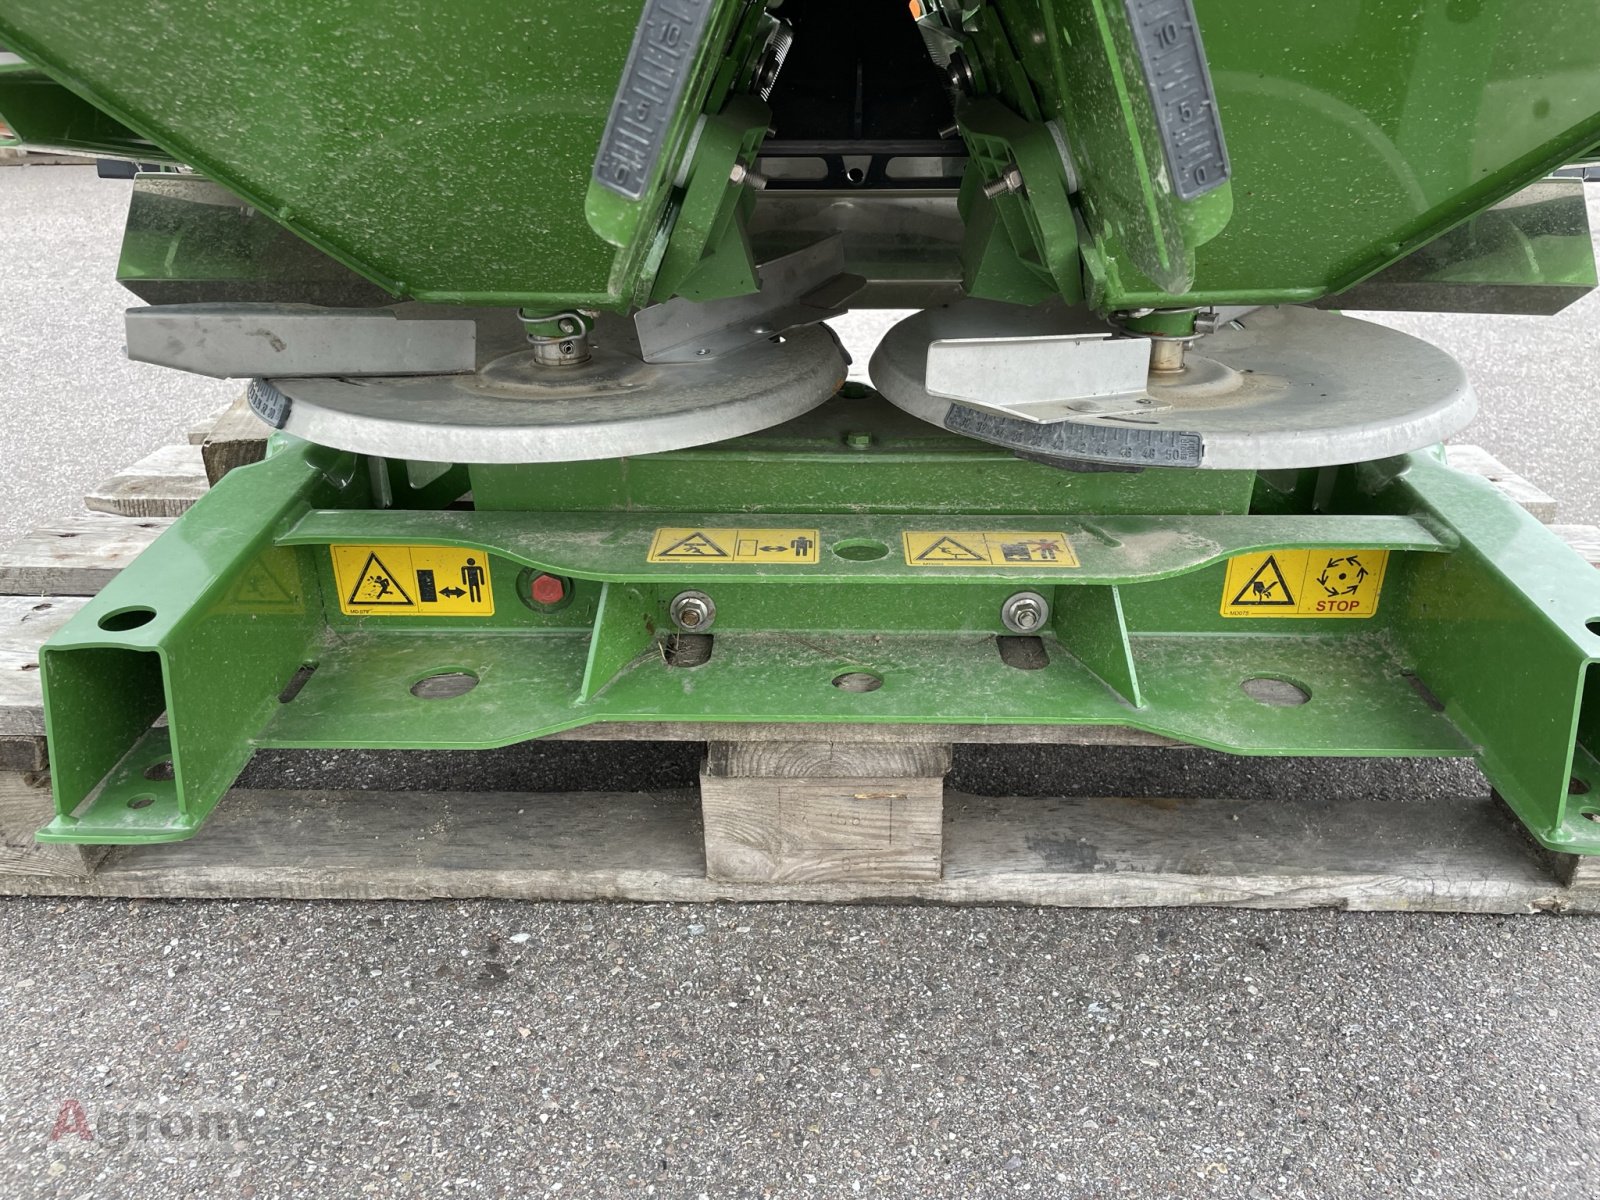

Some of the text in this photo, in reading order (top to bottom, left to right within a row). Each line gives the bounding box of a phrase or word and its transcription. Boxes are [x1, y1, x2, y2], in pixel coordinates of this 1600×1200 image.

[659, 21, 681, 47] 10
[1153, 22, 1177, 49] 10
[636, 100, 649, 121] 5
[1178, 101, 1193, 123] 5
[614, 163, 630, 185] 0
[1194, 165, 1206, 185] 0
[1165, 448, 1180, 460] 50
[1316, 600, 1360, 612] STOP
